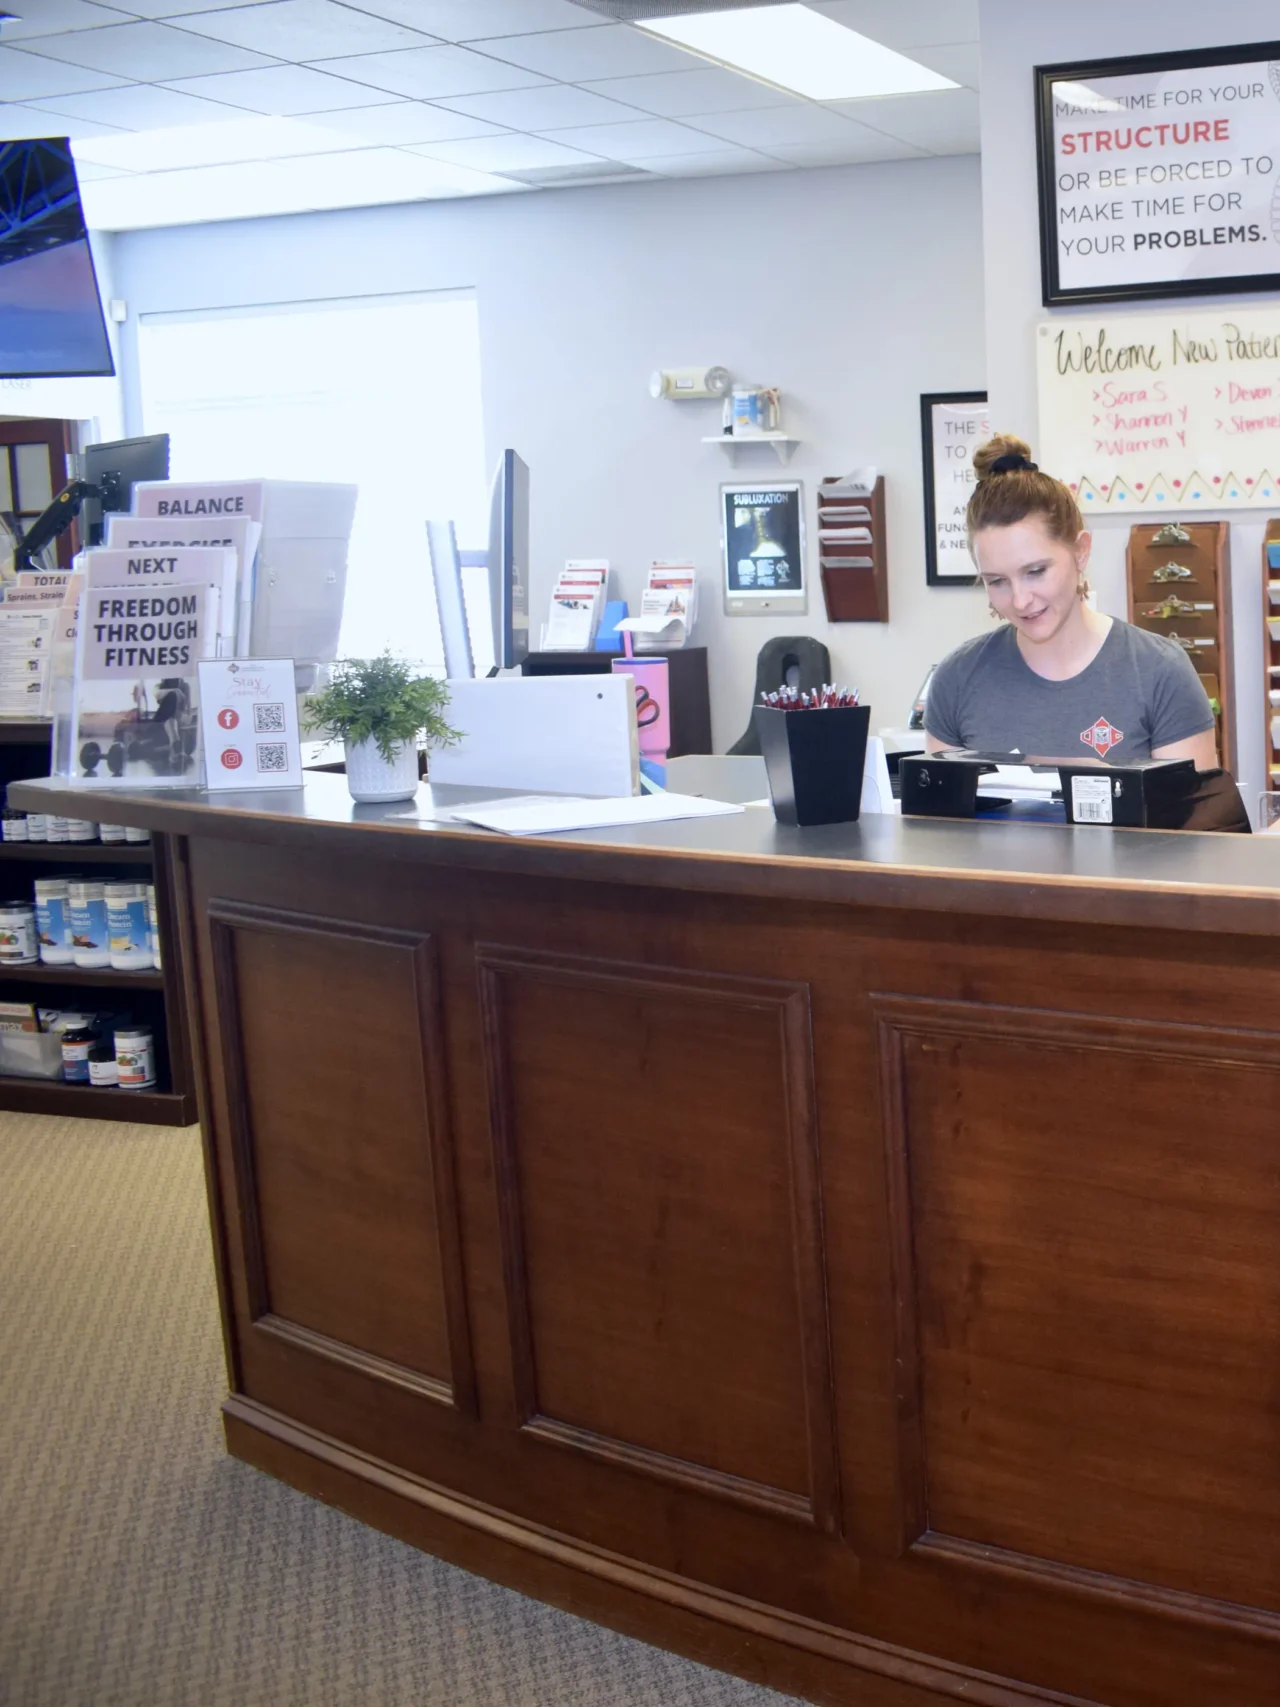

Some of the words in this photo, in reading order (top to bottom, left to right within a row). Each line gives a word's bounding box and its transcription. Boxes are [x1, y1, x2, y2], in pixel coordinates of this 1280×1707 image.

[1055, 97, 1107, 117] MAKE
[1116, 93, 1157, 111] TIME
[1164, 88, 1202, 106] FOR
[1209, 83, 1264, 102] YOUR
[1061, 119, 1230, 155] STRUCTURE
[1059, 172, 1090, 191] OR
[1099, 168, 1127, 188] BE
[1136, 159, 1232, 185] FORCED
[1241, 156, 1273, 175] TO
[1060, 202, 1124, 224] MAKE
[1132, 197, 1185, 217] TIME
[1194, 192, 1242, 213] FOR
[1061, 235, 1125, 256] YOUR
[1133, 224, 1267, 250] PROBLEMS.
[1055, 328, 1161, 375] Welcome
[1173, 328, 1217, 365] New
[1102, 381, 1147, 408] Sara
[1153, 381, 1168, 402] S
[944, 421, 975, 435] THE
[944, 445, 967, 459] TO
[158, 496, 244, 516] BALANCE
[734, 493, 789, 505] SUBLUXATION
[128, 558, 178, 575] NEXT
[99, 595, 197, 619] FREEDOM
[94, 619, 198, 644] THROUGH
[105, 645, 190, 668] FITNESS
[233, 677, 262, 693] Stay
